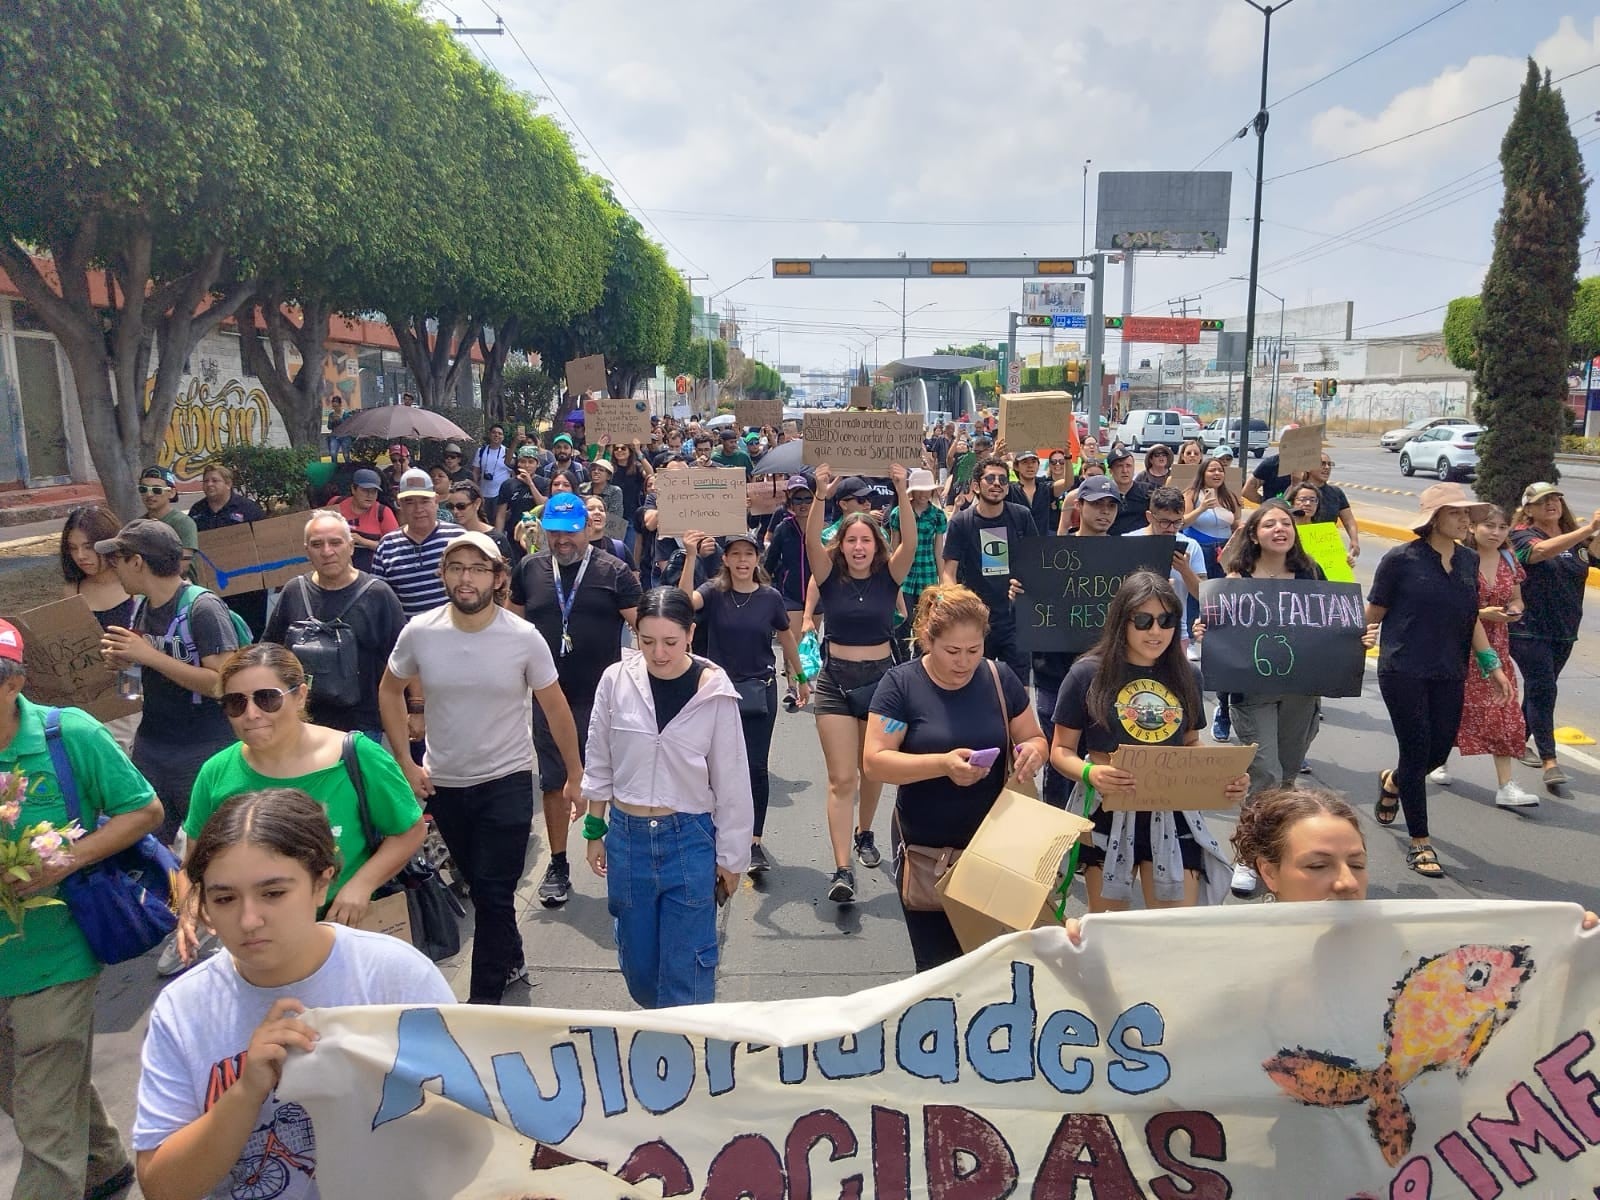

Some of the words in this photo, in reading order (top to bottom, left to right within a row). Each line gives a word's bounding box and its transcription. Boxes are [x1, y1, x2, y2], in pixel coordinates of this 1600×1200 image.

[681, 476, 690, 486] el
[693, 476, 728, 486] cambio
[730, 480, 744, 490] que
[667, 492, 700, 504] quieres
[722, 492, 734, 500] en
[679, 509, 687, 519] el
[690, 508, 720, 519] Mundo
[1041, 549, 1083, 571] LOS
[1062, 572, 1127, 599] ÁRBO
[1032, 603, 1057, 628] SE
[1070, 602, 1111, 629] RES
[1203, 591, 1272, 628] #NOS
[1278, 591, 1364, 629] FALTAN
[1253, 633, 1295, 677] 63
